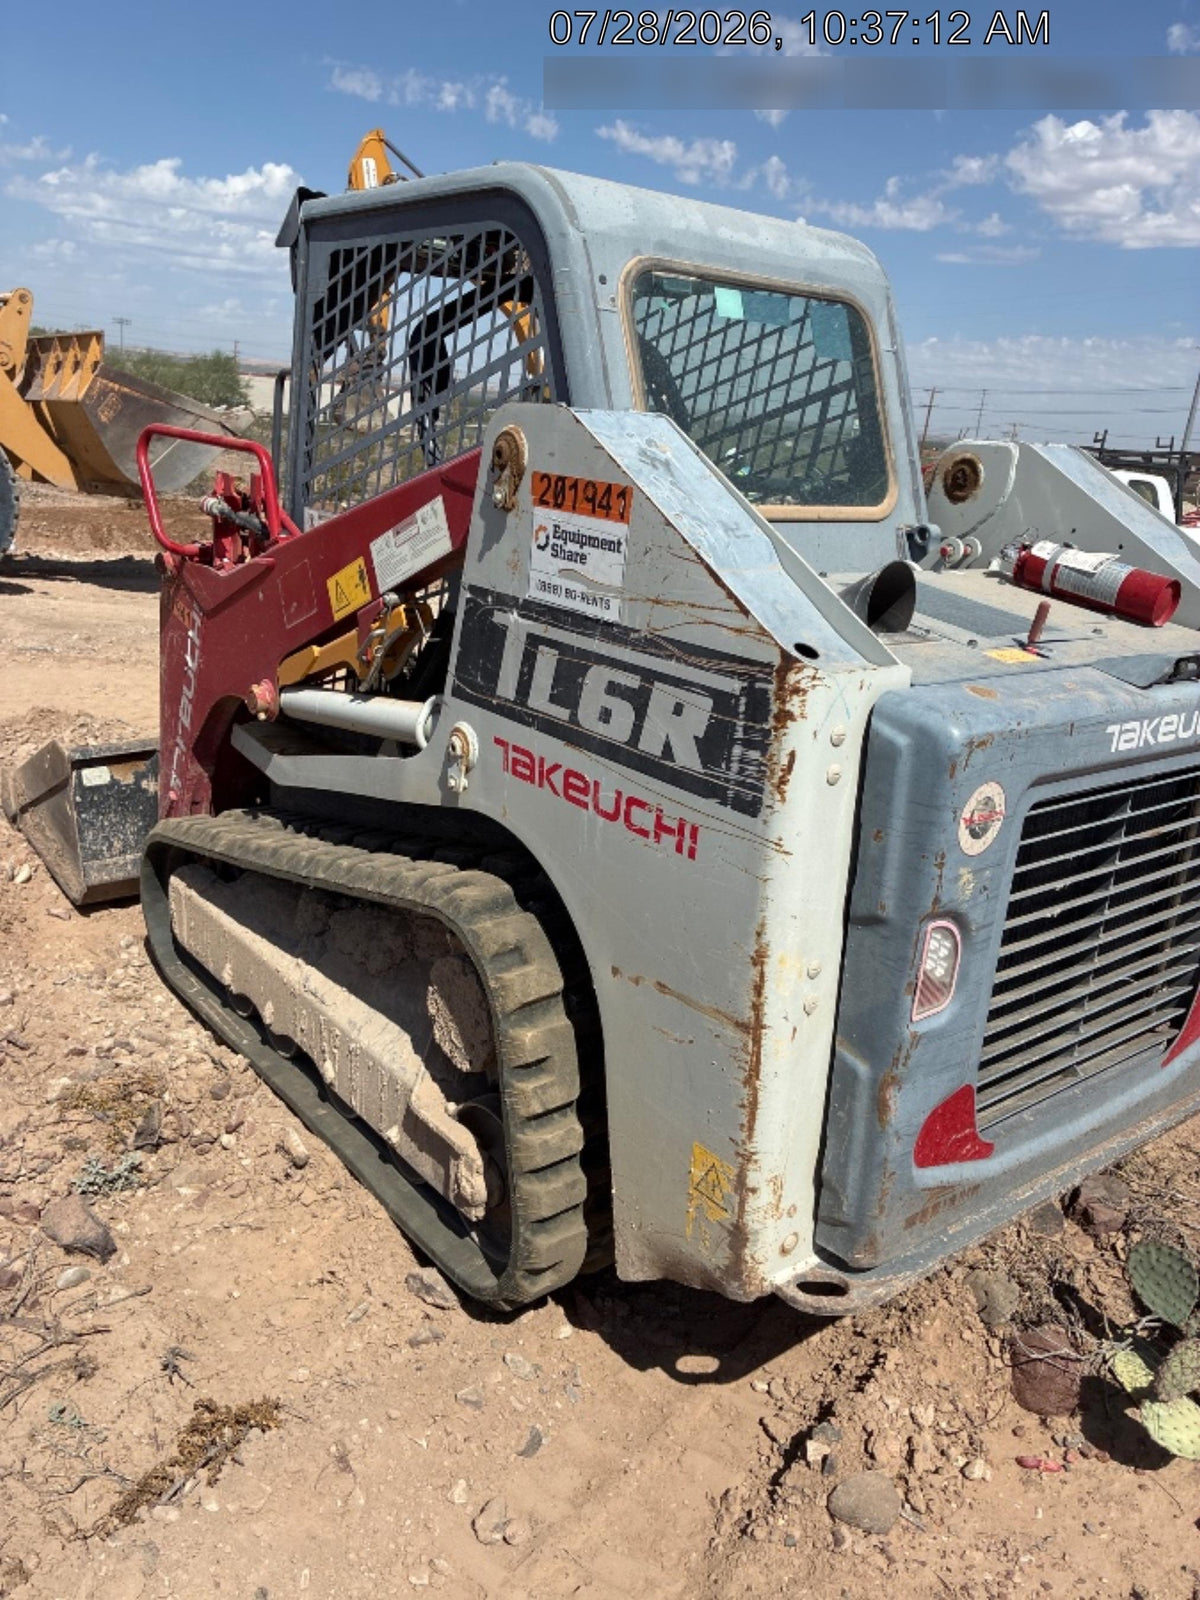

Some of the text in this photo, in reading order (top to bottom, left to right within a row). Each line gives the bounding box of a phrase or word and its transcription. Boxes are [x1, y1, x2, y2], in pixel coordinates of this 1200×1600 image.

[538, 473, 629, 520] 201941
[551, 544, 588, 566] Share
[552, 524, 624, 554] Equipment
[487, 609, 717, 771] TL6R
[1105, 710, 1200, 753] TAKEU
[493, 736, 699, 861] TAKEUCHI
